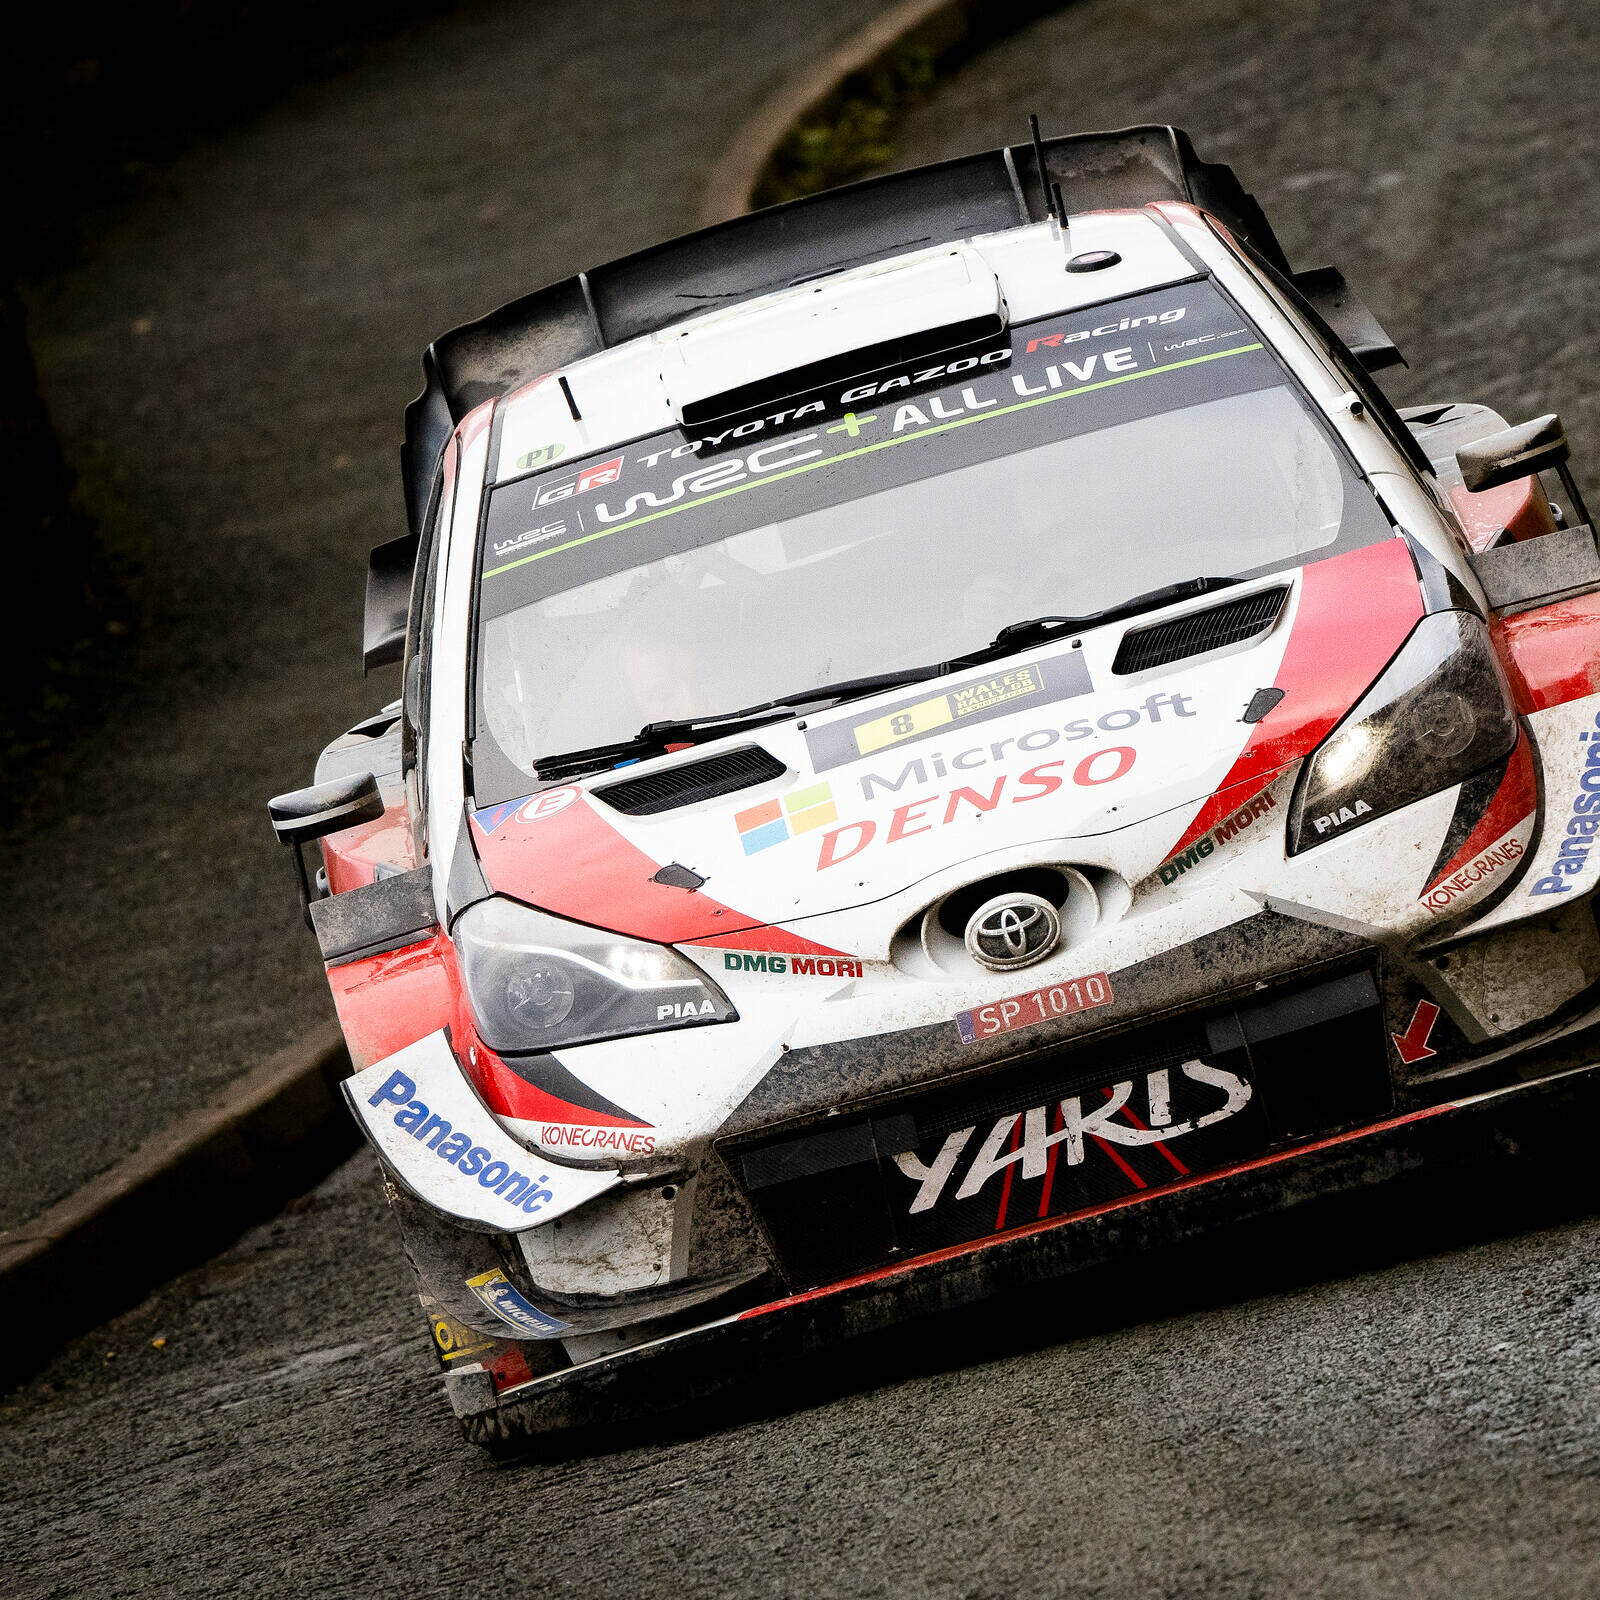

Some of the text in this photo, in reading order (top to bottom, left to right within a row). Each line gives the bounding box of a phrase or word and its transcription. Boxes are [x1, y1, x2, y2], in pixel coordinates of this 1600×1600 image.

[636, 307, 1186, 468] TOYOTA GAZOO Racing
[892, 387, 998, 432] ALL
[1011, 346, 1138, 396] LIVE
[526, 444, 554, 468] P1
[538, 468, 617, 505] GR
[953, 669, 1031, 701] WALES
[956, 687, 1006, 709] RALLY
[890, 713, 915, 736] 8
[860, 692, 1197, 801] Microsoft
[816, 746, 1137, 872] DENSO
[1312, 799, 1373, 834] PIAA
[1158, 790, 1276, 886] DMG MORI
[1420, 838, 1524, 915] KONECRANES
[724, 952, 863, 978] DMG MORI
[657, 999, 716, 1021] PIAA
[979, 977, 1105, 1033] SP 1010
[368, 1069, 553, 1214] Panasonic
[541, 1125, 656, 1154] KONECRANES
[891, 1058, 1253, 1214] YARIS
[498, 1300, 555, 1331] MICHELIN
